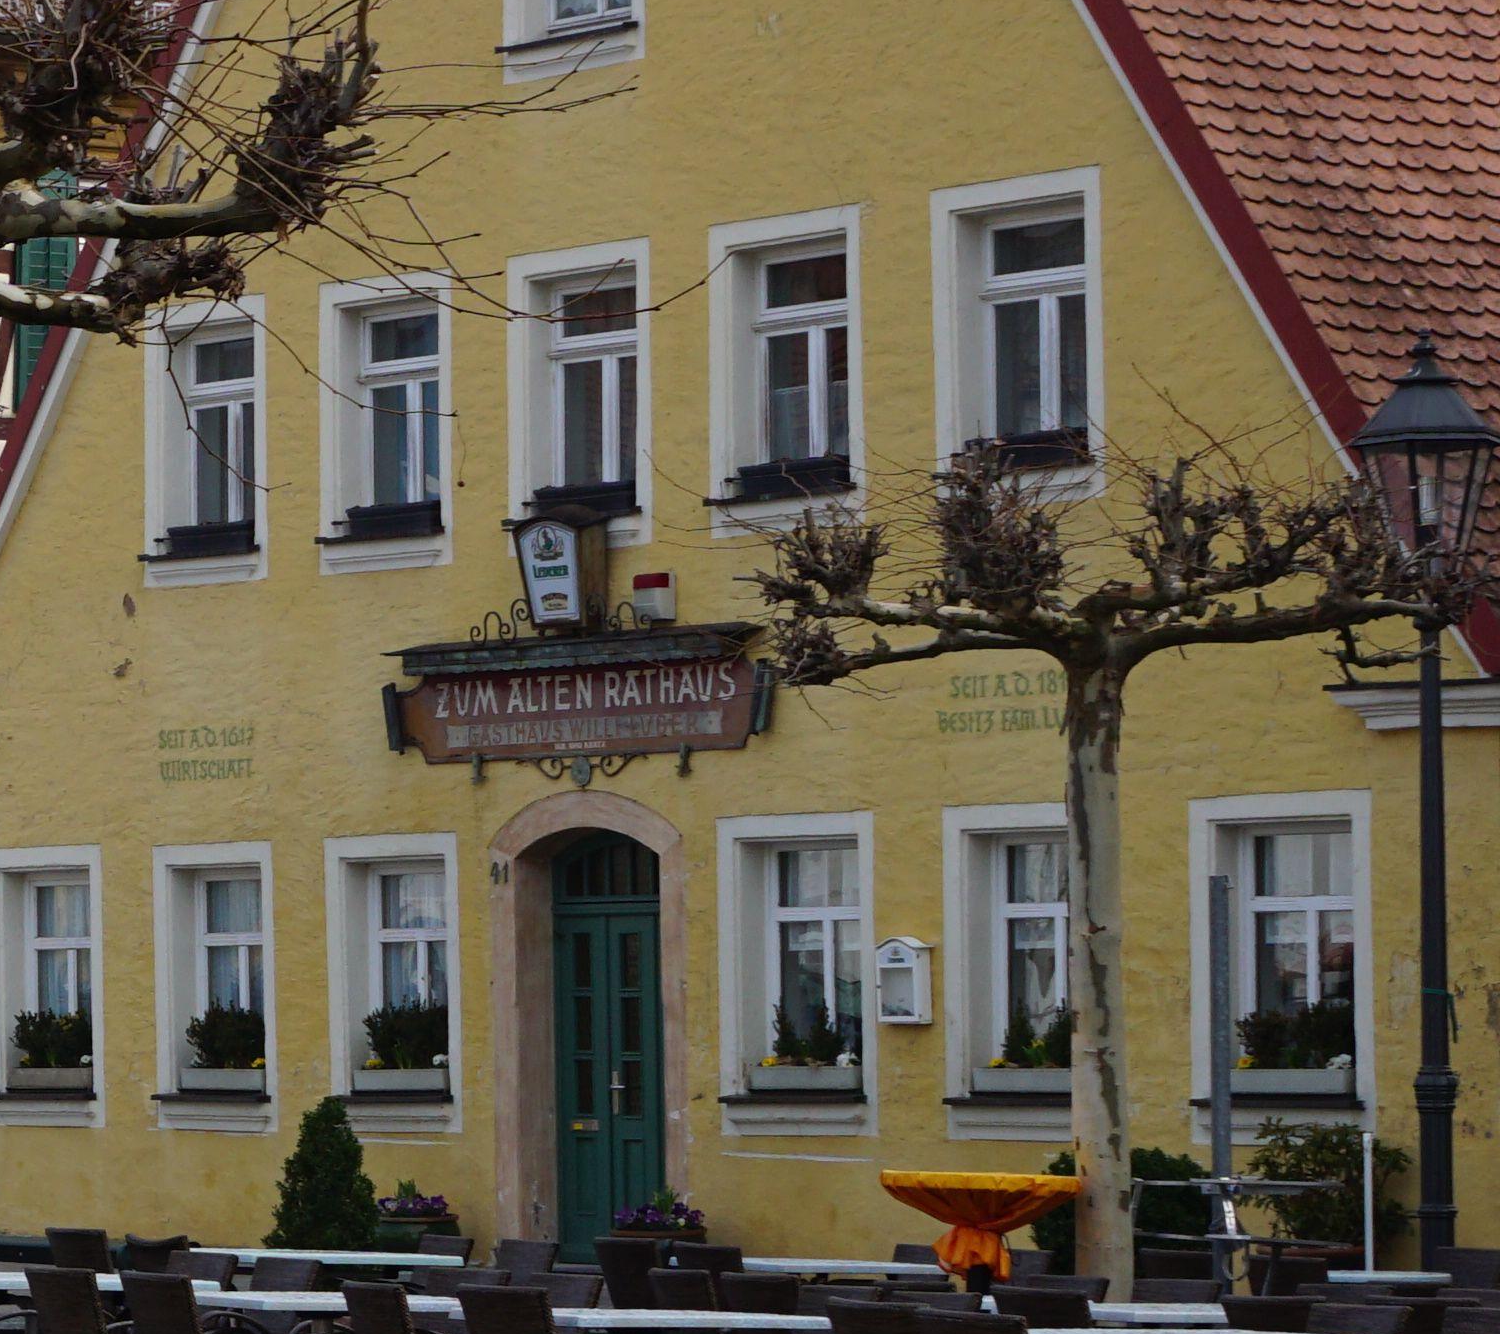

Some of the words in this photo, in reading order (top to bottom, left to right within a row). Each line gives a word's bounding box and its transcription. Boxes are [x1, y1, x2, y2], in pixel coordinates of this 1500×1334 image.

[435, 680, 499, 718] ZUM
[506, 673, 593, 714] ALTEN
[604, 661, 736, 708] RATHAUS
[950, 675, 990, 700] SEIT
[158, 729, 187, 749] SEIT
